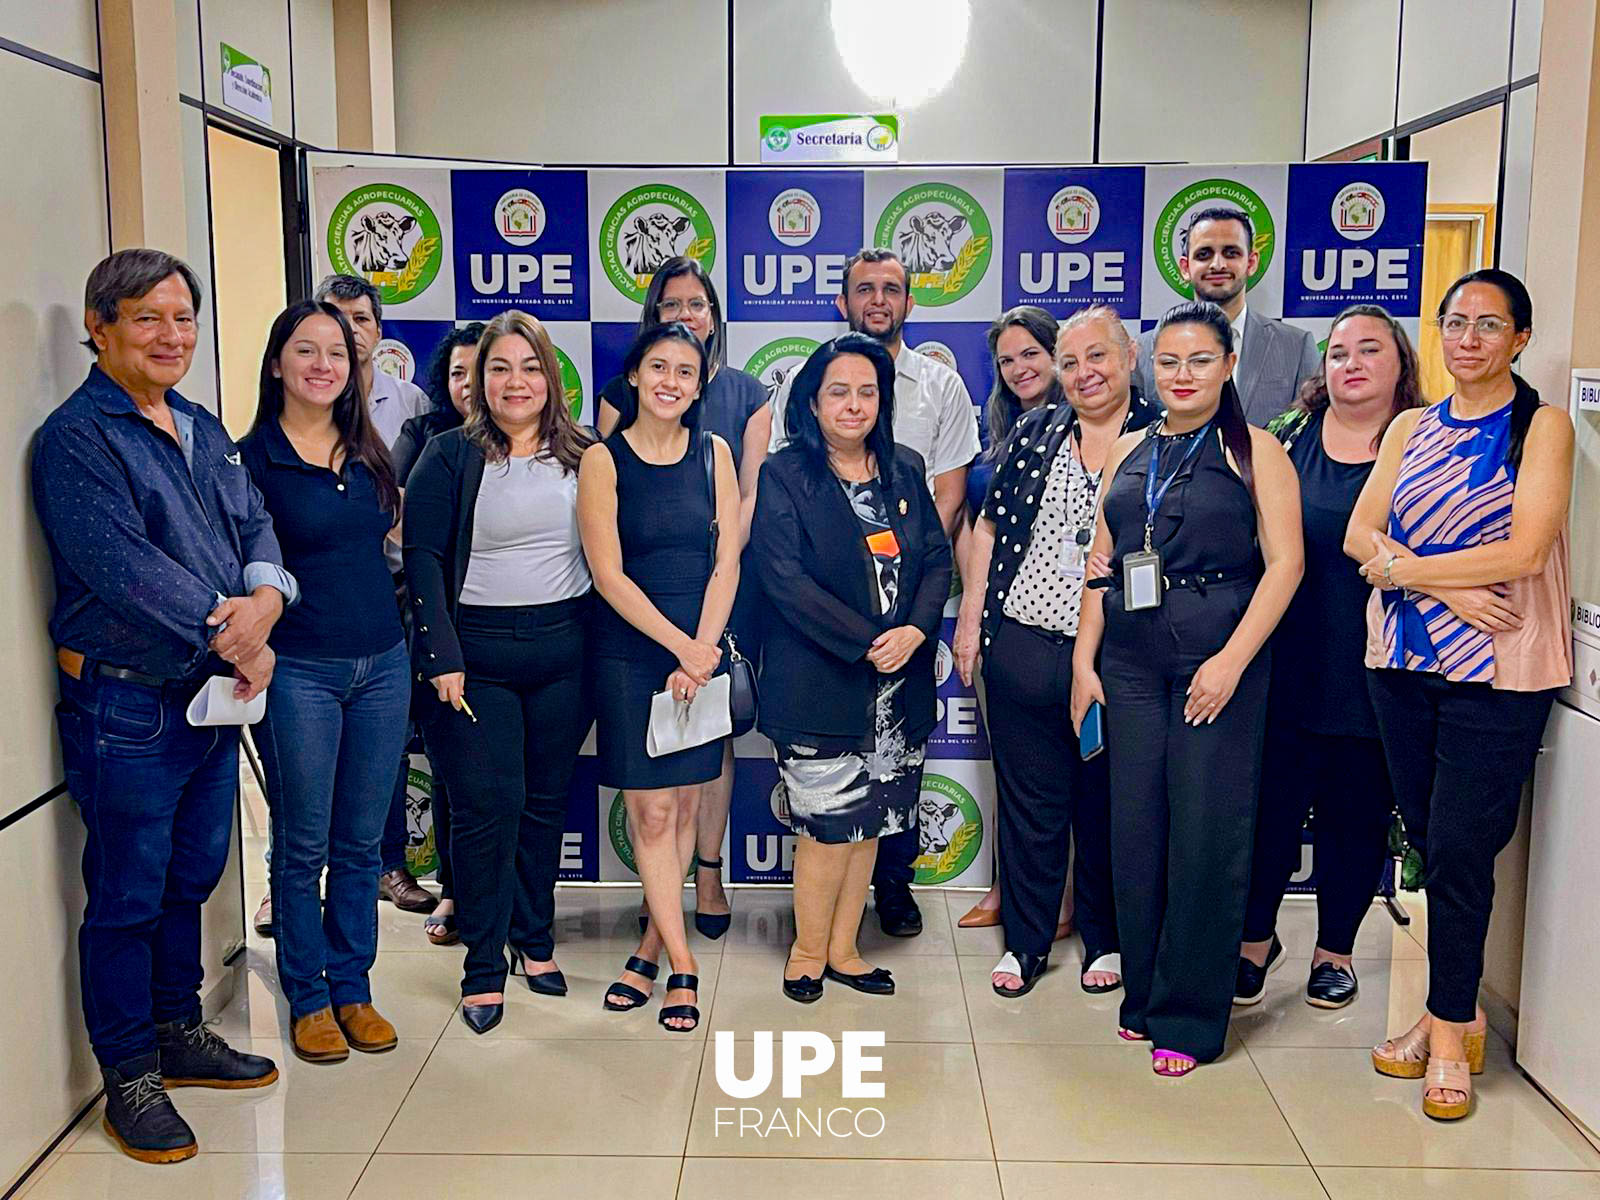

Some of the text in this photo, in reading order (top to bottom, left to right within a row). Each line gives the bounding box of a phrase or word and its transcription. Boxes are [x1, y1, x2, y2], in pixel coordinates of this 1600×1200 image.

[334, 191, 425, 276] ULTAD CIENCIAS AGROPECUARIAS
[881, 190, 975, 247] CIENCIAS AGROPECUARIAS
[1161, 202, 1184, 244] CIENCIAS
[1184, 187, 1258, 213] AGROPECUARIAS
[606, 192, 698, 292] FACULTAD CIENCIAS AGROPECUARIAS
[470, 254, 573, 294] UPE
[744, 254, 846, 296] UPE
[1020, 252, 1125, 294] UPE
[1302, 249, 1410, 291] UPE
[765, 344, 813, 361] AGROPECU
[922, 780, 966, 805] PECUARIAS
